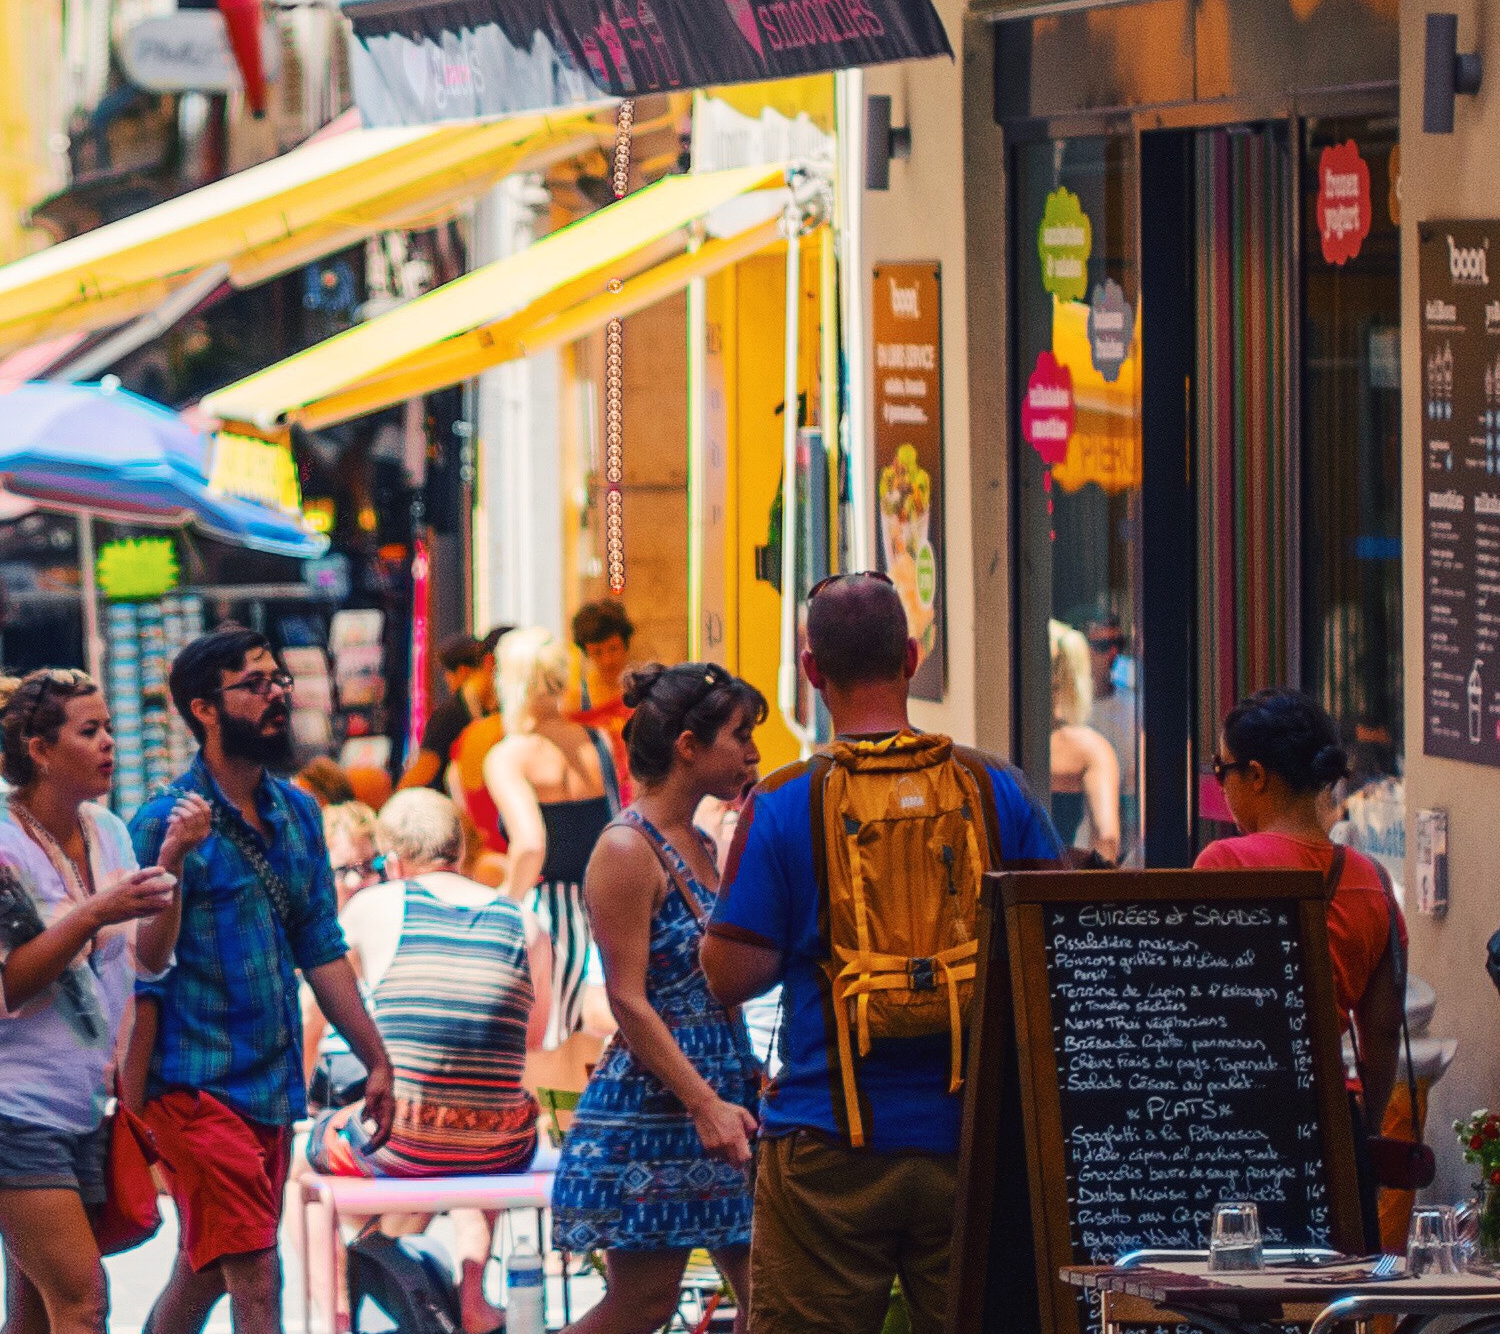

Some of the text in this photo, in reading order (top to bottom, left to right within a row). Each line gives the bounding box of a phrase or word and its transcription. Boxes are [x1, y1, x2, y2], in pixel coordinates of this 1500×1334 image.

[1324, 203, 1359, 240] yogurt
[1193, 905, 1272, 927] SALADES
[1138, 937, 1199, 951] maison
[1057, 983, 1118, 997] Terrine
[1121, 981, 1141, 997] de
[1067, 1074, 1122, 1091] Salade
[1146, 1095, 1218, 1120] PLATS
[1071, 1125, 1141, 1150] Spaghetti
[1076, 1185, 1127, 1204] Daube
